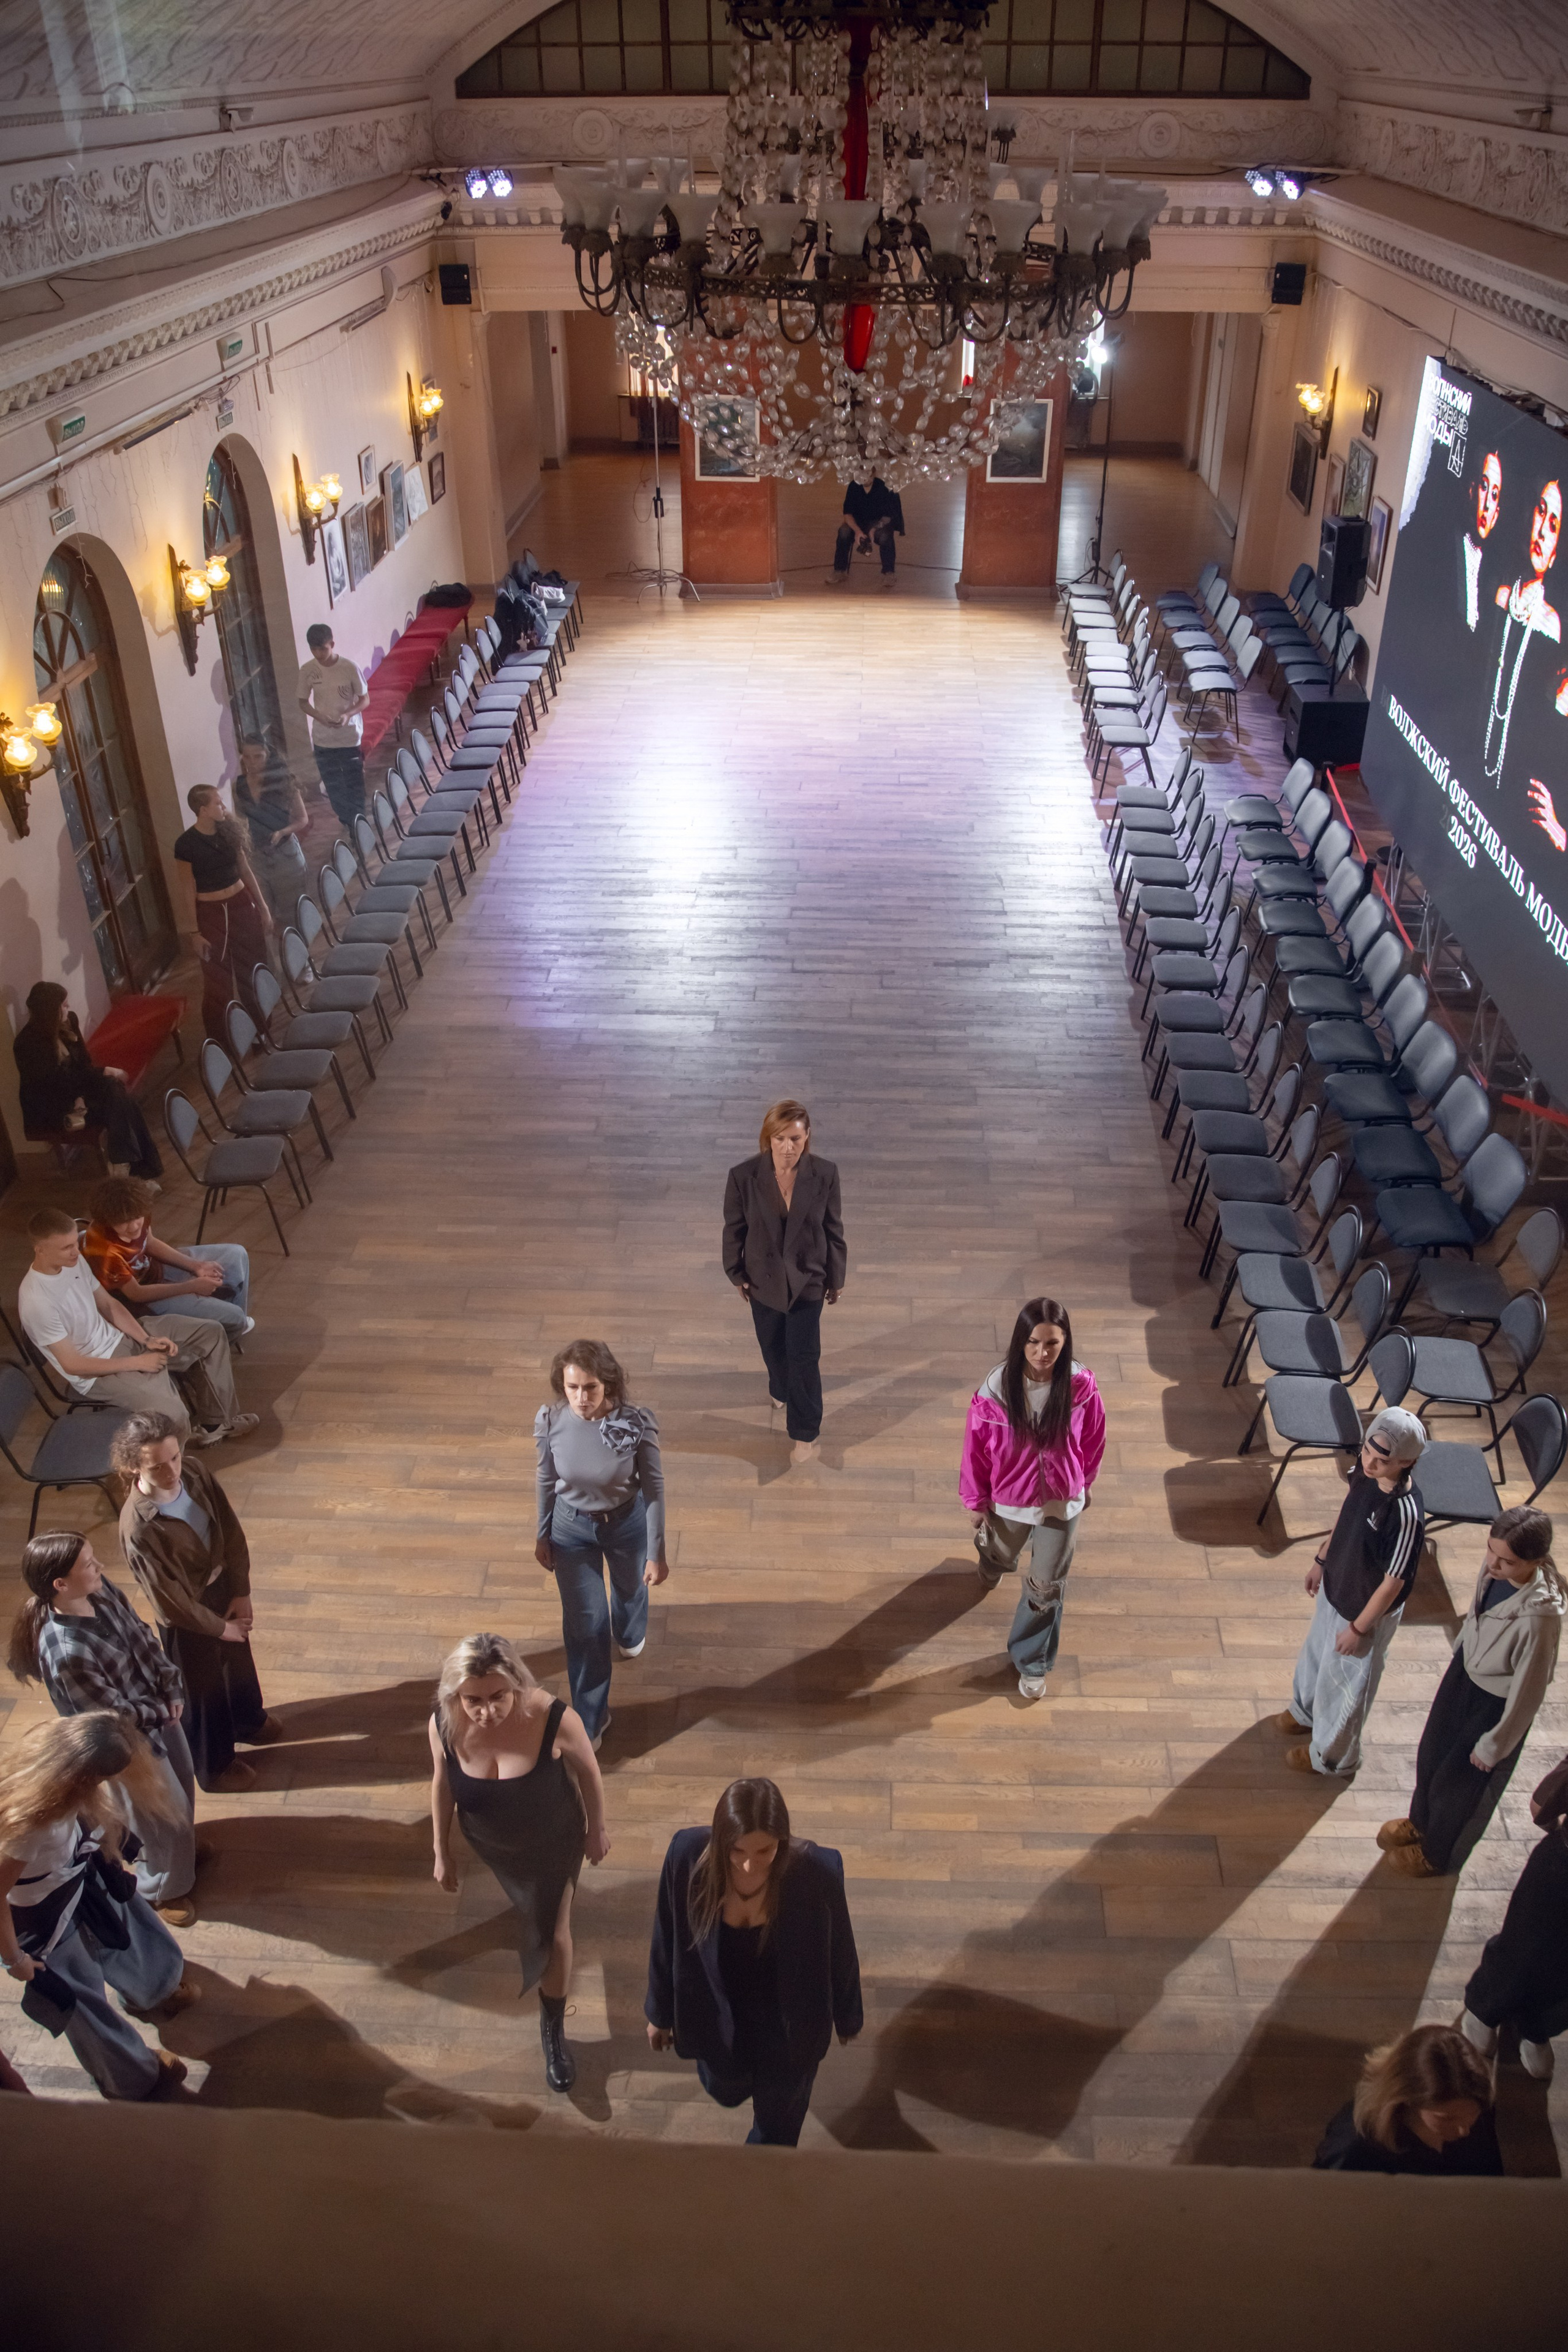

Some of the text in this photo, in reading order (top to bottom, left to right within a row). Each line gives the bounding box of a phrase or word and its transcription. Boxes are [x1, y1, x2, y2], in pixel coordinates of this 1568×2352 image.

[1427, 394, 1468, 435] ЕСТИВАЛЬ
[1388, 694, 1450, 792] ВОЛЖСКИЙ
[1449, 778, 1525, 897] ФЕСТИВАЛЬ
[1448, 815, 1477, 869] 2026
